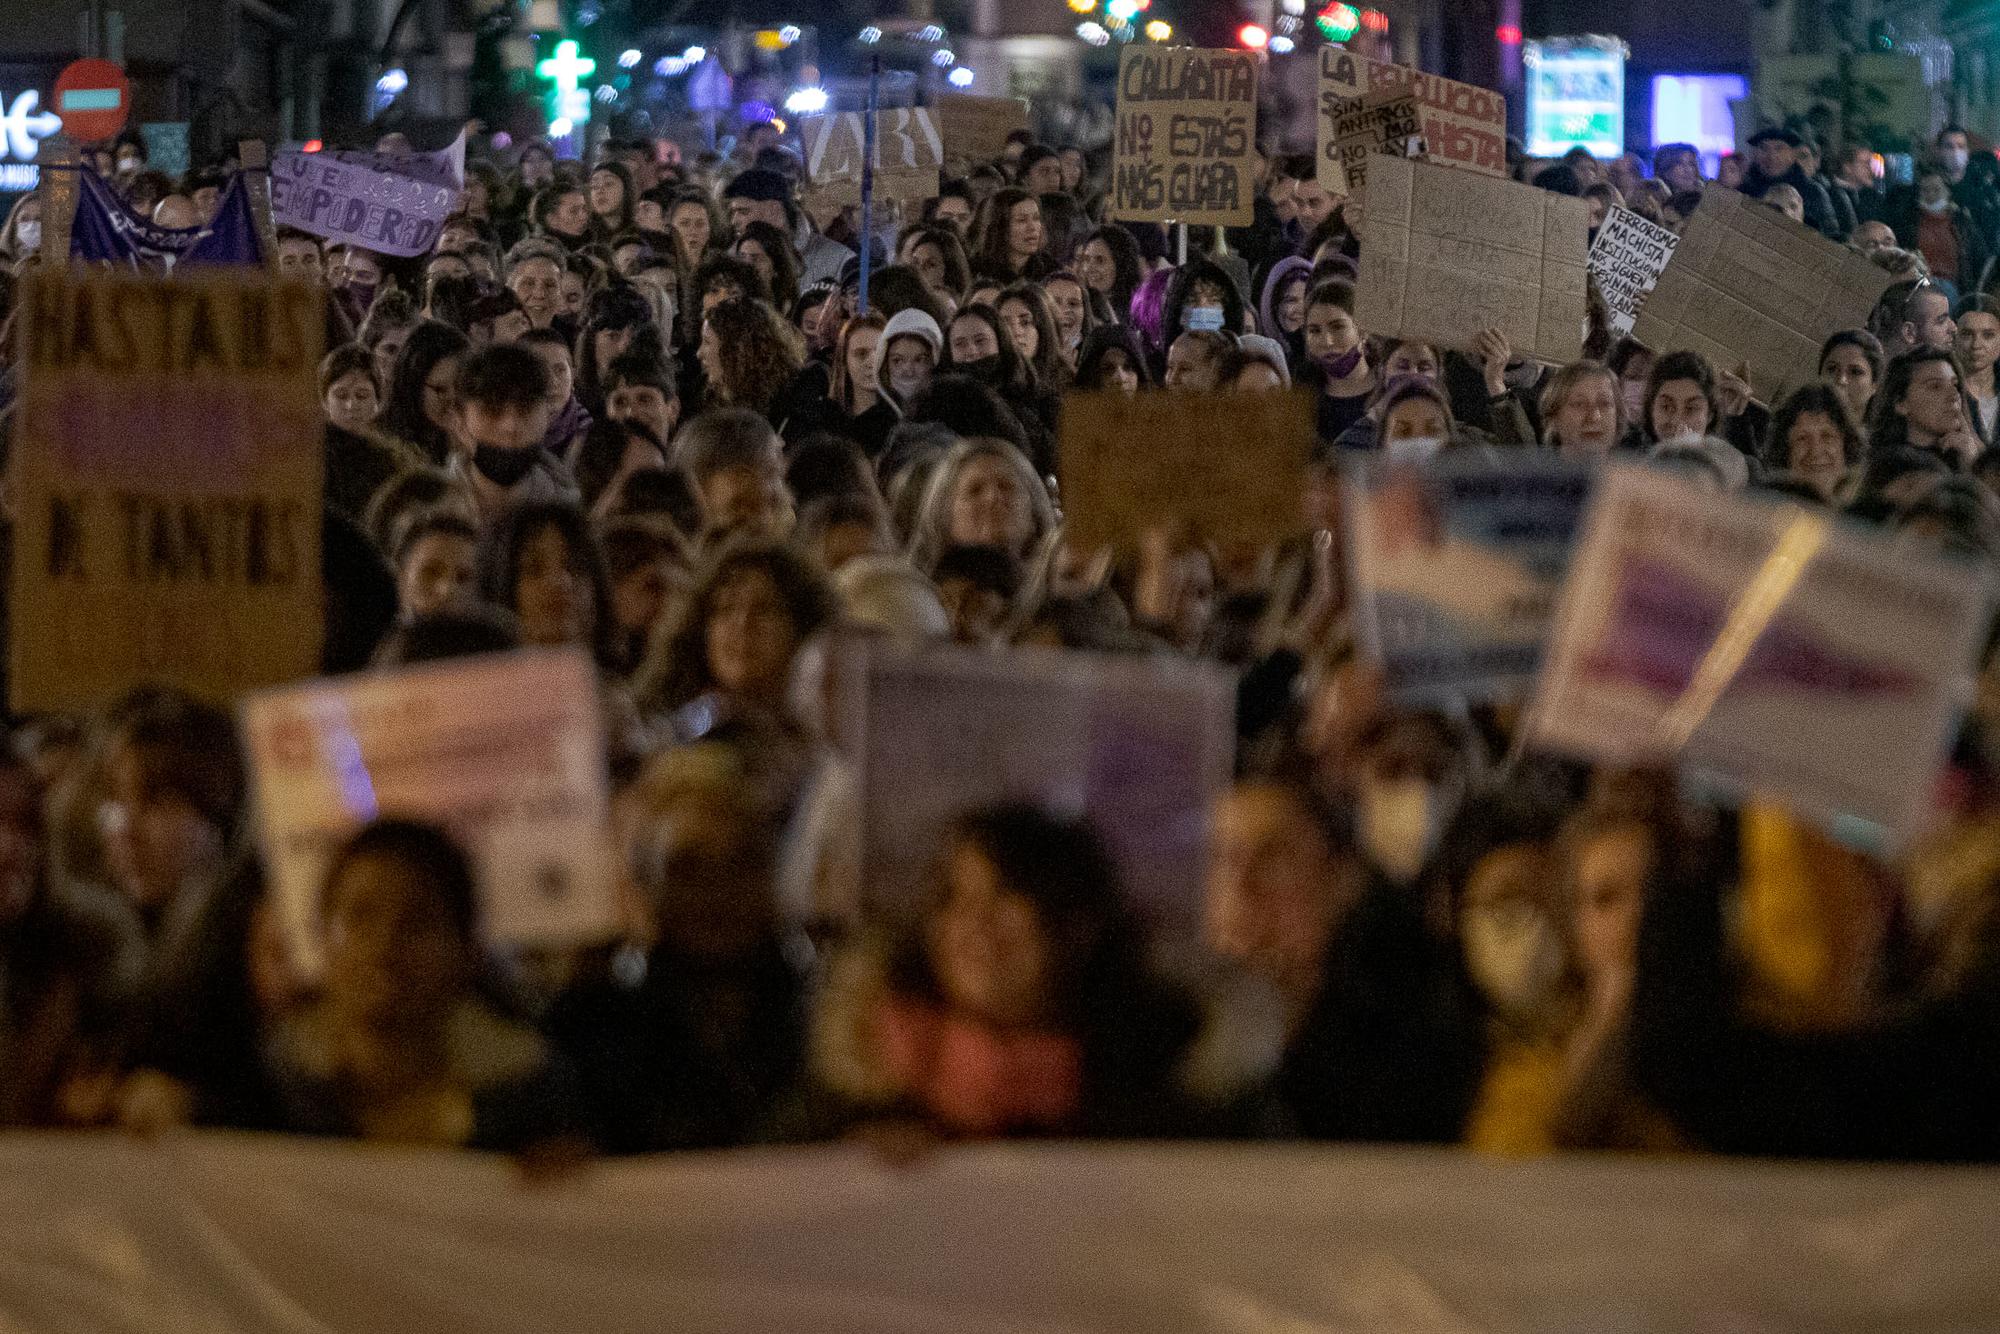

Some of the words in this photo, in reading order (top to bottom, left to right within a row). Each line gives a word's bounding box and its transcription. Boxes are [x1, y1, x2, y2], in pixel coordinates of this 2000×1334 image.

[1333, 98, 1363, 119] SIN
[1606, 222, 1665, 265] MACHISTA
[1612, 205, 1678, 250] TERRORISMO
[1588, 248, 1608, 266] NOS
[1609, 261, 1647, 288] SIGUEN
